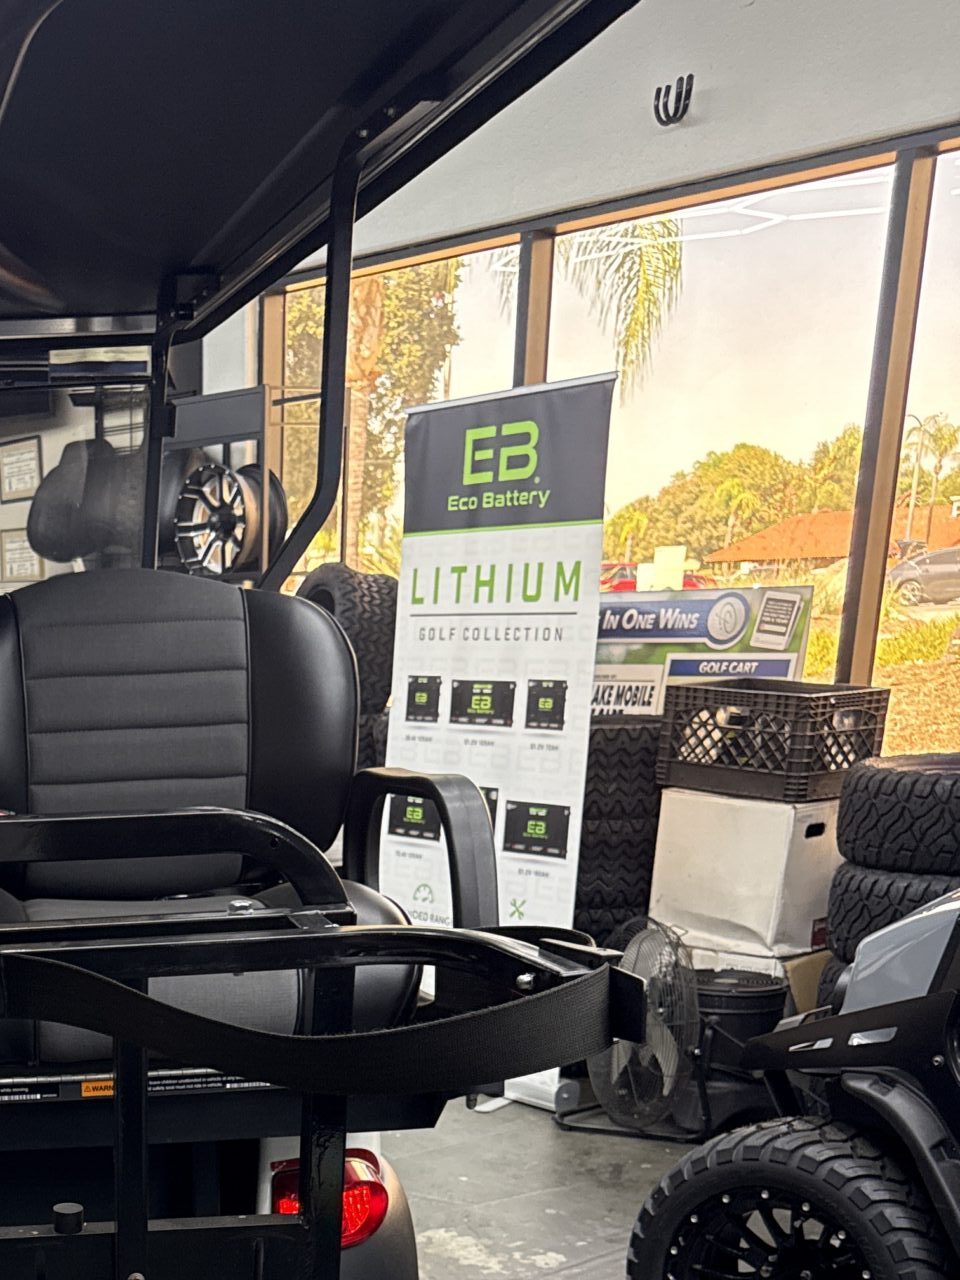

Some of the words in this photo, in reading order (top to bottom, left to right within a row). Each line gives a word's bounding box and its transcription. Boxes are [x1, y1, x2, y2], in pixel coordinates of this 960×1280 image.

[462, 420, 540, 485] EB
[447, 495, 477, 511] Eco
[482, 489, 550, 509] Battery
[411, 560, 582, 605] LITHIUM
[602, 609, 620, 630] IN
[622, 608, 656, 630] ONE
[658, 608, 699, 629] WINS
[418, 627, 456, 641] GOLF
[463, 627, 563, 642] COLLECTION
[698, 662, 728, 674] GOLF
[729, 661, 759, 674] CART
[592, 685, 614, 705] AKE
[614, 685, 656, 707] MOBILE
